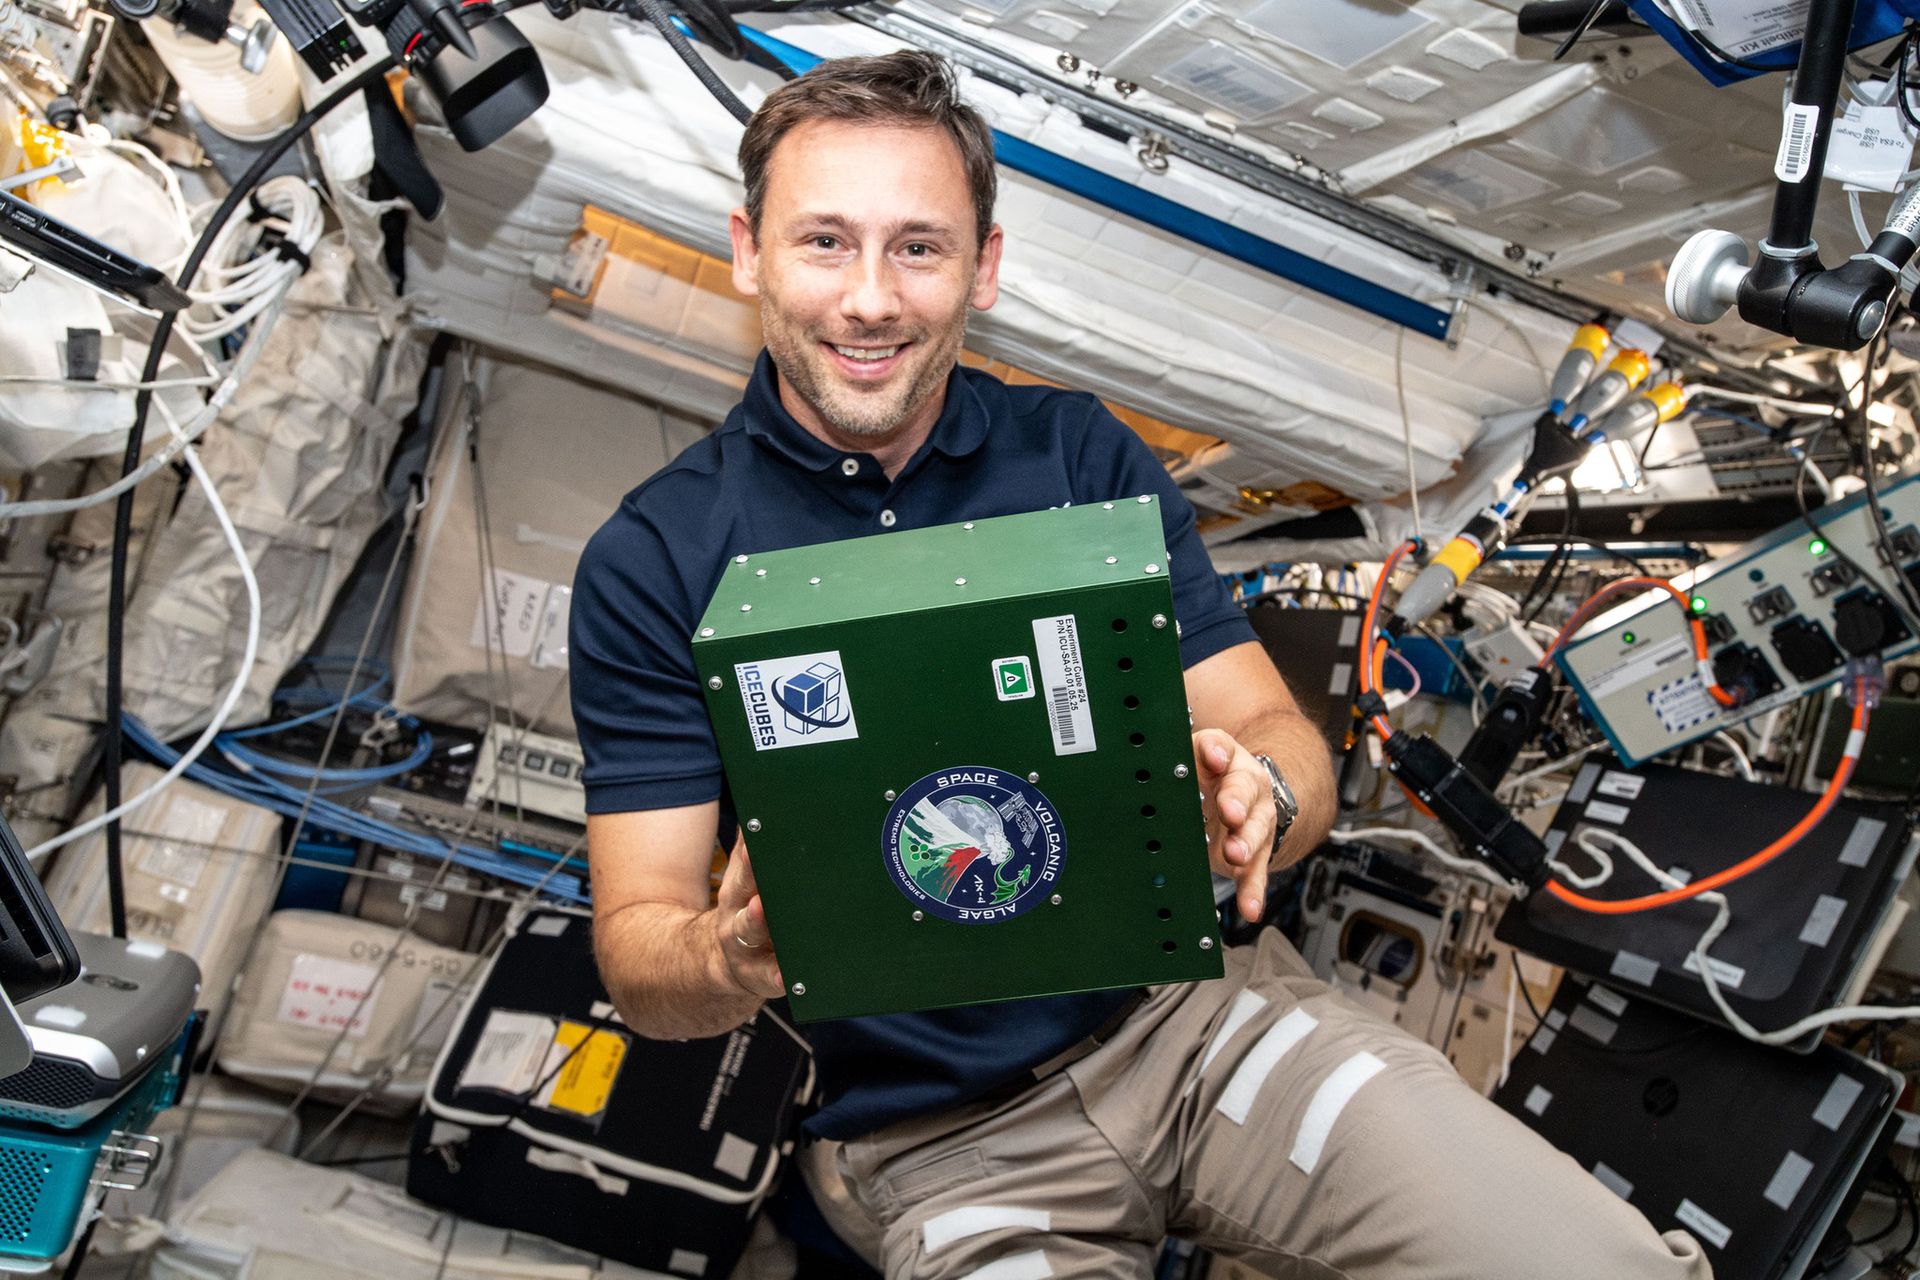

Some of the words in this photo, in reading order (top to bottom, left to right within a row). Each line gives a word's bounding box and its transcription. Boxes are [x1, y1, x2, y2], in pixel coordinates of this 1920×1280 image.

[1740, 40, 1760, 53] Kit
[1056, 619, 1066, 634] P/N
[1059, 635, 1079, 712] ICU-SA-01.01.05.25
[1065, 618, 1080, 664] Experiment
[1073, 664, 1083, 687] Cube
[1078, 688, 1087, 703] #24
[736, 666, 742, 674] BY
[743, 689, 754, 726] APPLICATIONS
[751, 726, 761, 749] SERVICES
[743, 665, 777, 746] ICECUBES
[937, 772, 999, 788] SPACE
[890, 809, 906, 844] EXTREMO
[1034, 801, 1061, 882] VOLCANIC
[891, 845, 926, 901] TECHNOLOGIES
[958, 902, 1016, 920] ALGAE
